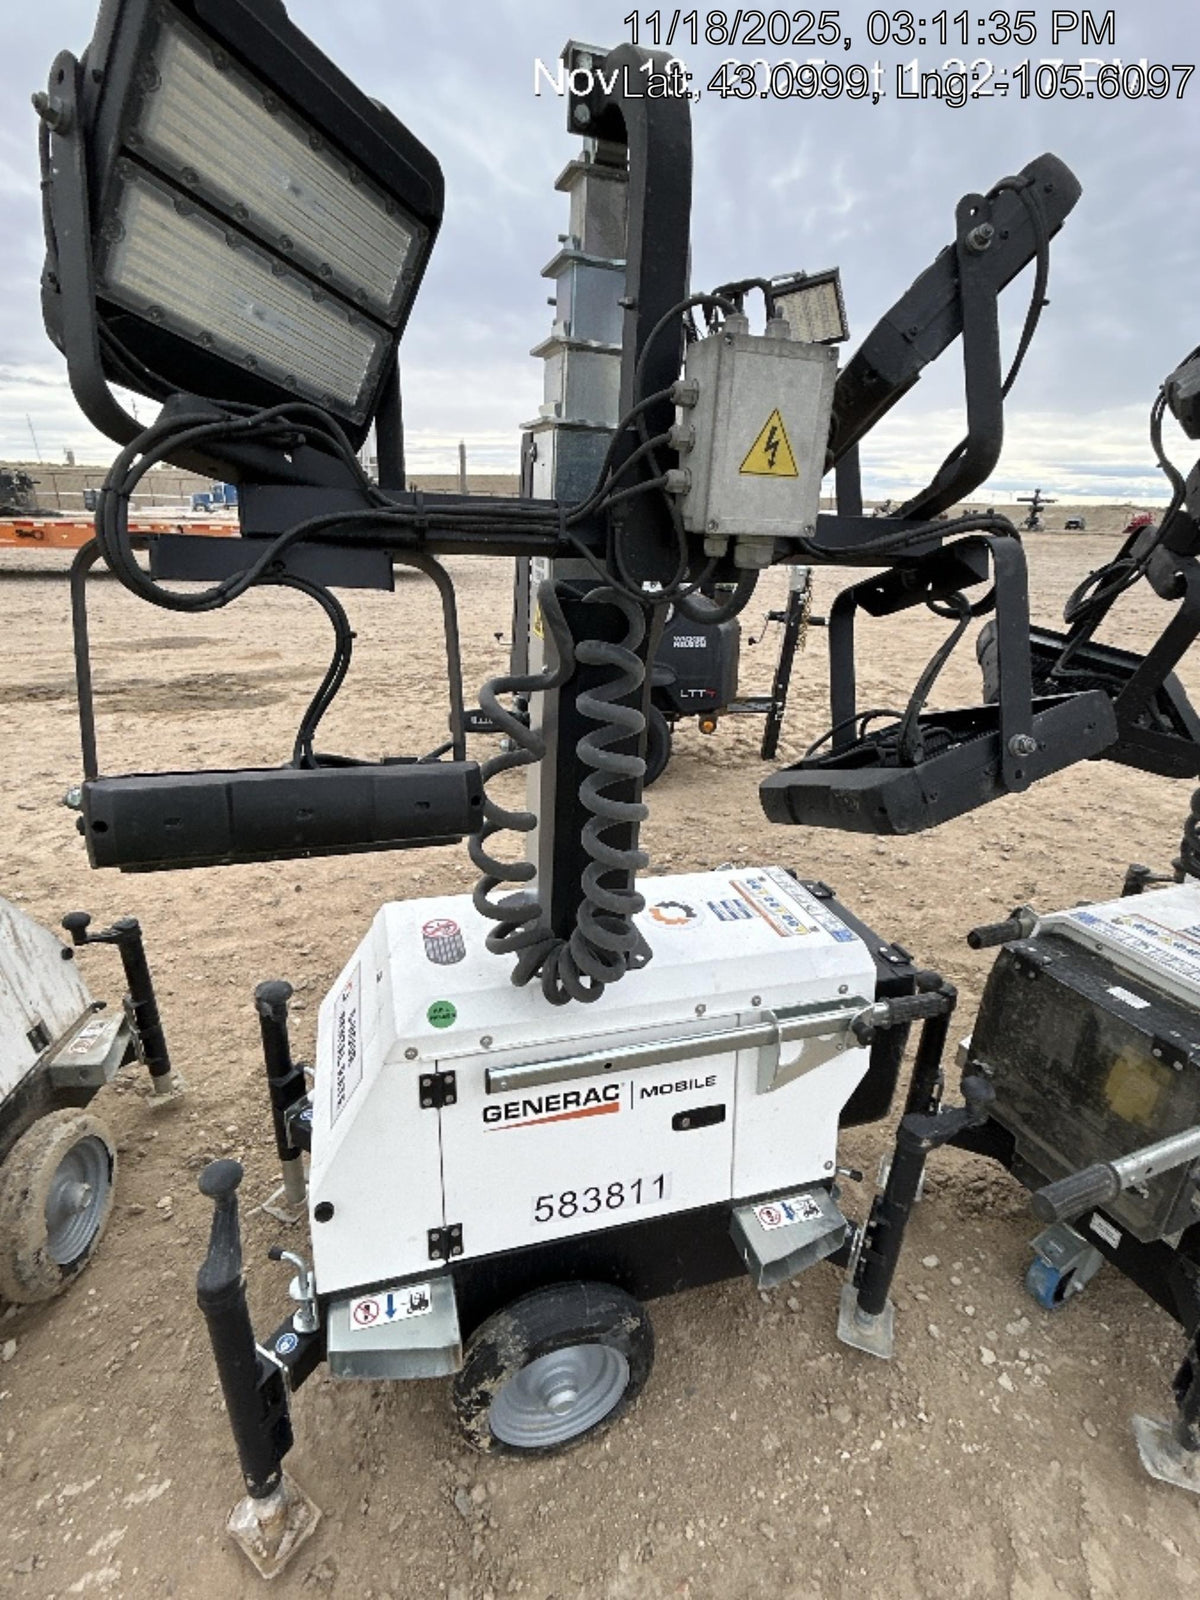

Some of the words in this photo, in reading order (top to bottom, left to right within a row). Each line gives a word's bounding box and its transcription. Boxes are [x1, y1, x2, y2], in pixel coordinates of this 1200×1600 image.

[483, 1083, 620, 1123] GENERAC
[640, 1075, 717, 1099] MOBILE
[534, 1173, 665, 1223] 583811
